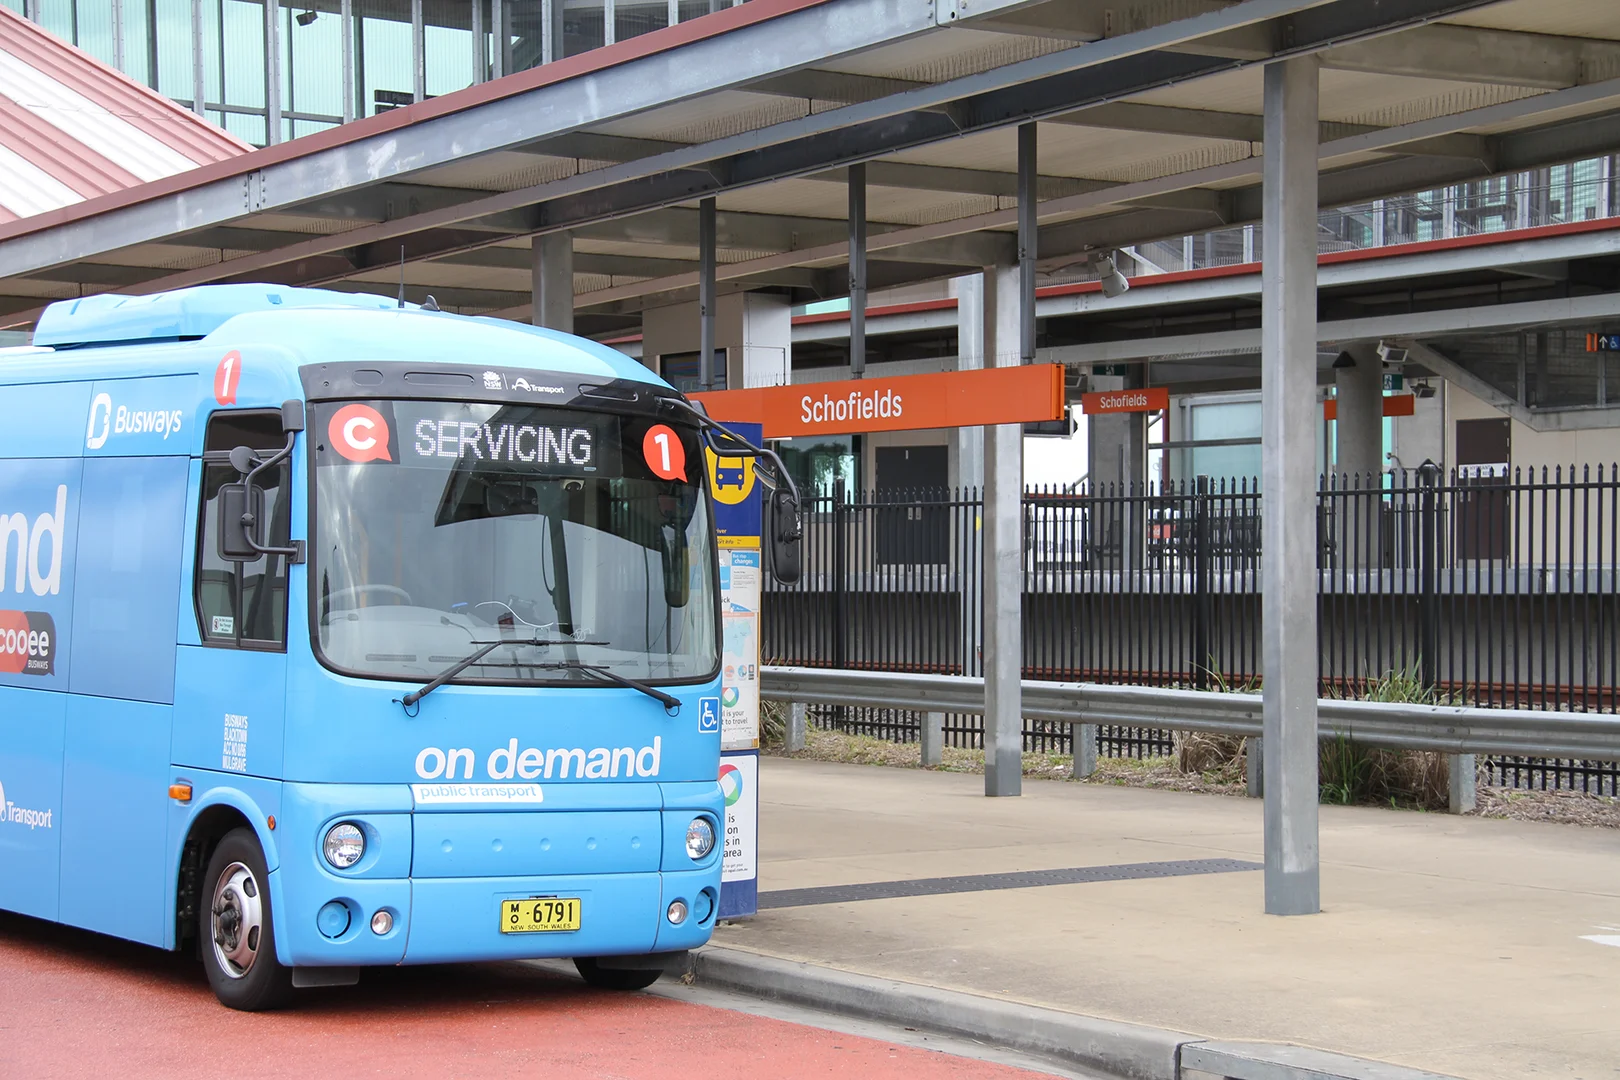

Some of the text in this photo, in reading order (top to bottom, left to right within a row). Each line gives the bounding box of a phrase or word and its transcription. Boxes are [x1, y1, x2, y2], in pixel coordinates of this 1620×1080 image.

[222, 357, 235, 397] 1
[484, 380, 502, 388] NSW
[530, 384, 564, 394] Transport
[800, 388, 902, 424] Schofields
[1100, 394, 1147, 409] Schofields
[114, 406, 182, 440] Busways
[342, 416, 378, 450] C
[414, 419, 592, 465] SERVICING
[653, 432, 671, 472] 1
[0, 628, 50, 656] cooee
[28, 660, 48, 669] BUSWAYS
[224, 713, 248, 729] BUSWAYS
[224, 727, 248, 743] BLACKTOWN
[222, 755, 247, 772] MULGRAVE
[414, 736, 662, 780] on demand
[420, 785, 537, 800] public transport
[6, 801, 52, 830] Transport
[728, 813, 735, 823] is
[732, 836, 740, 845] in
[533, 902, 572, 923] 6791
